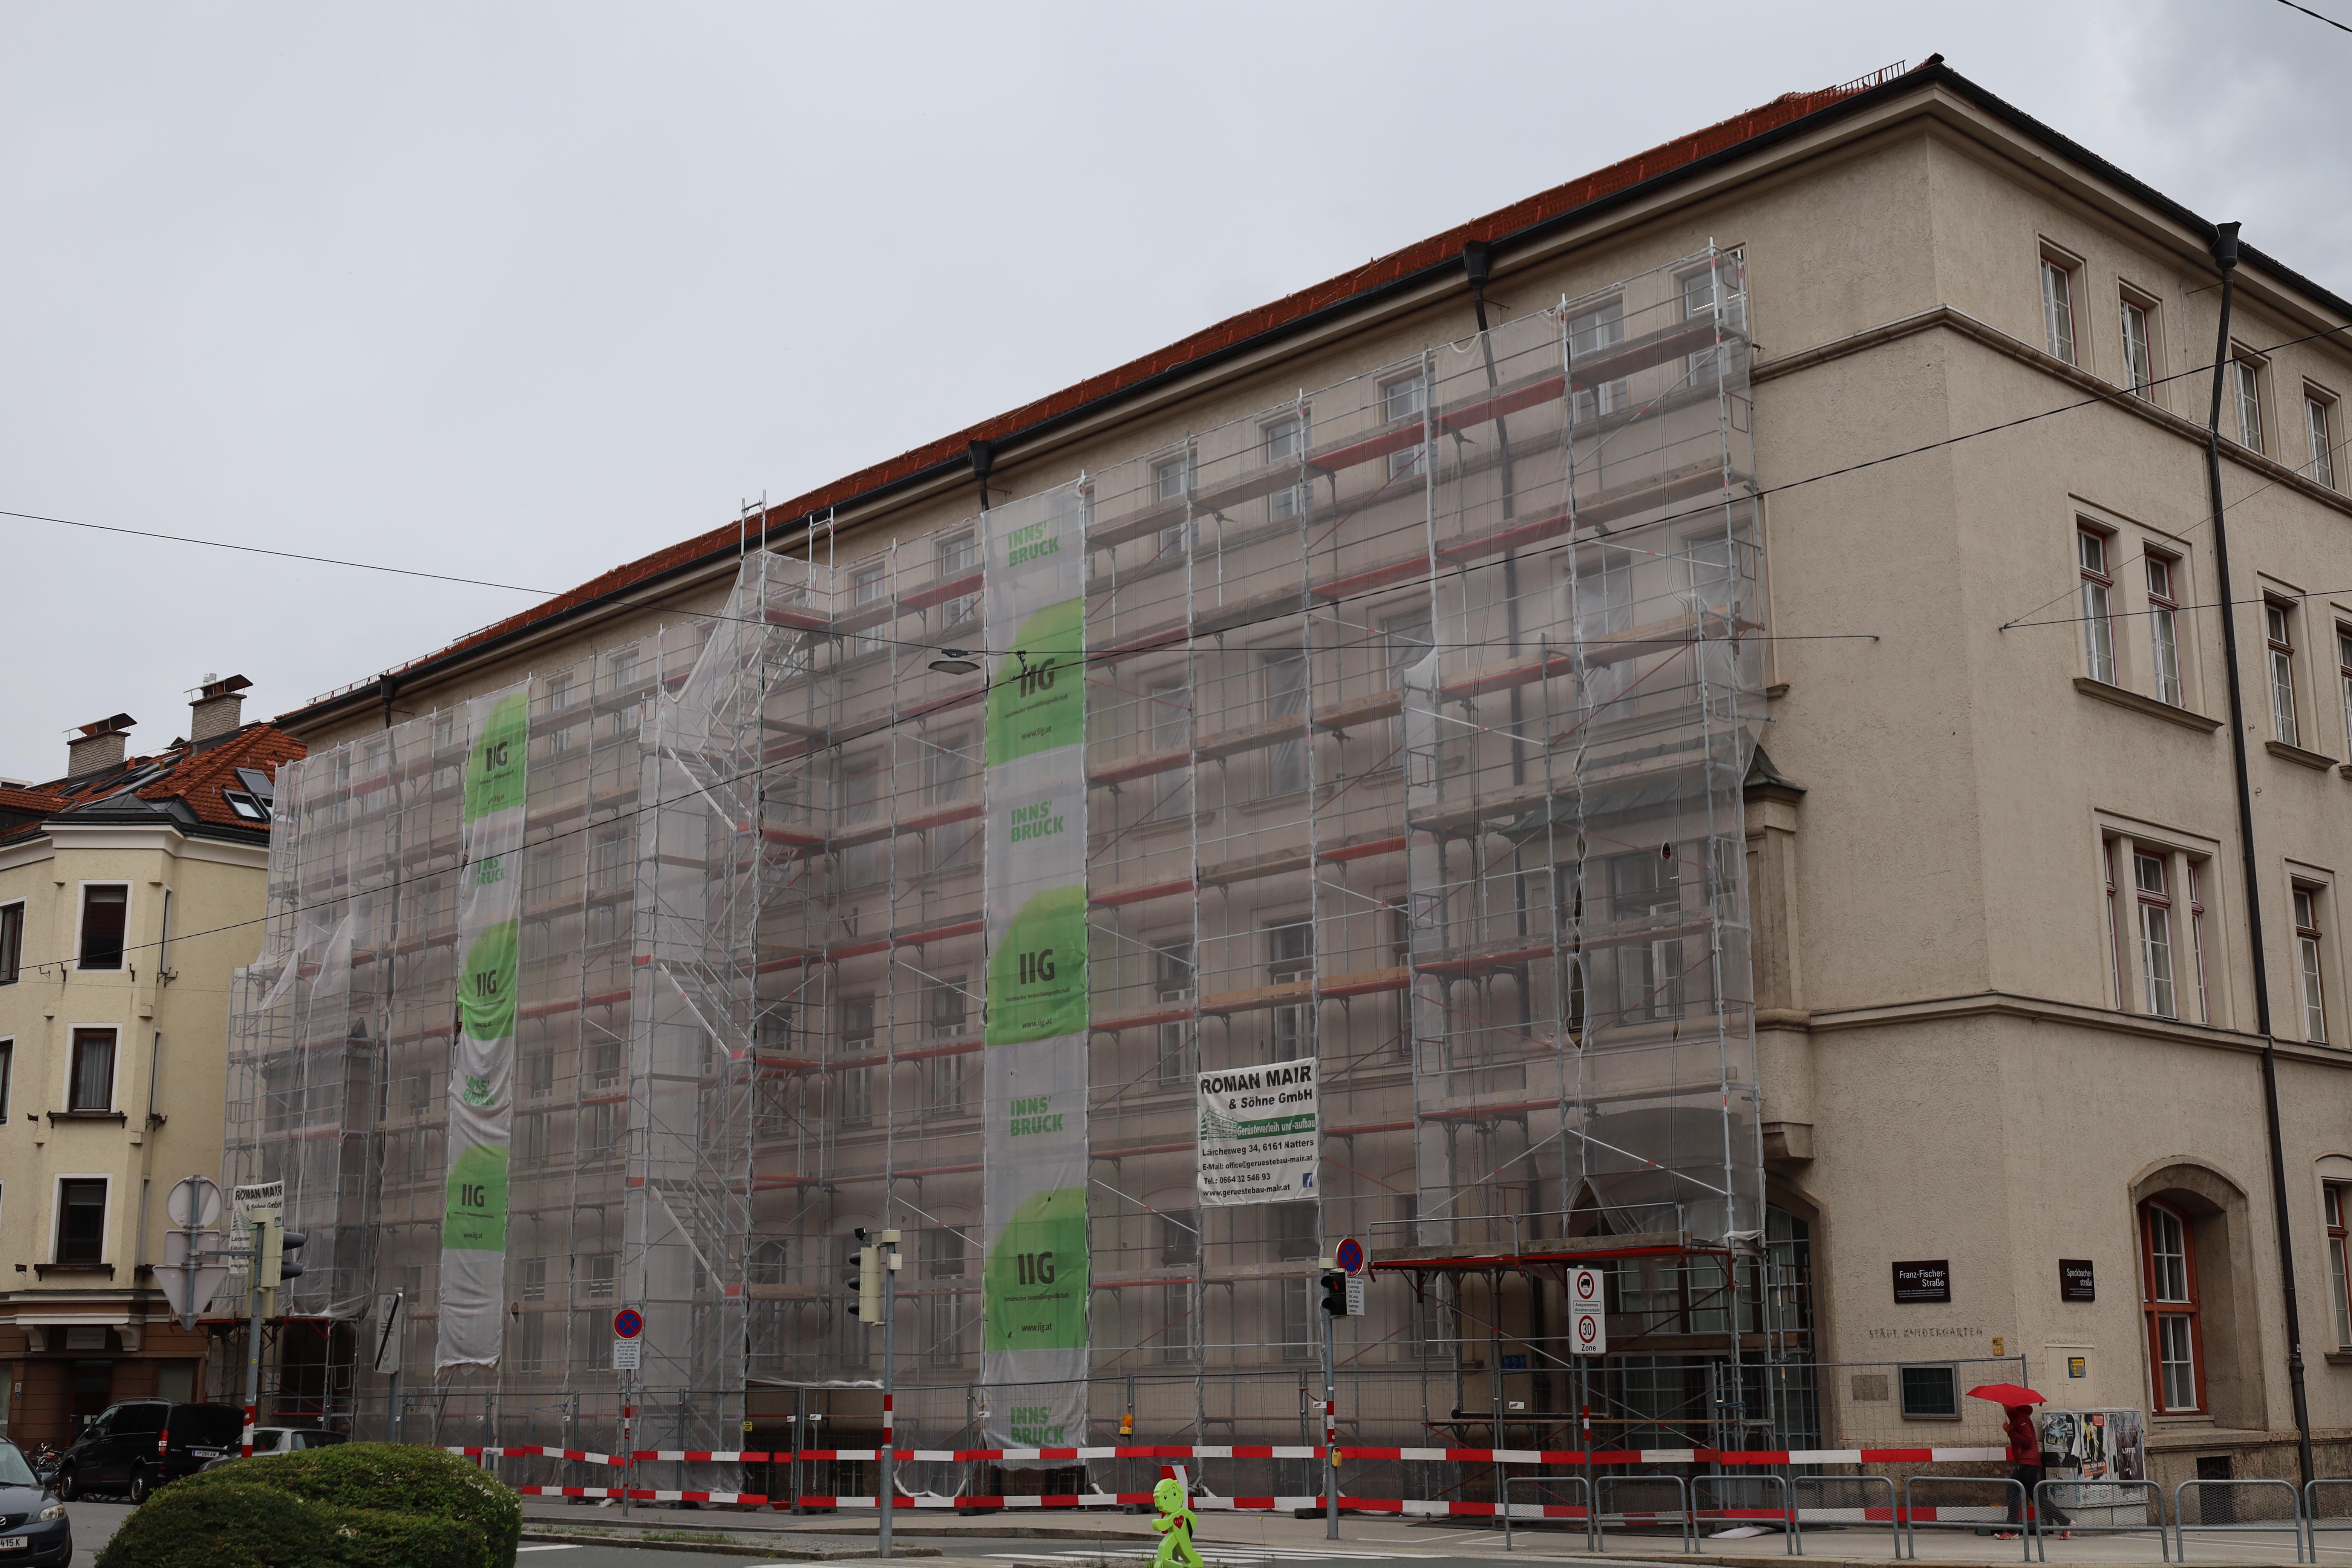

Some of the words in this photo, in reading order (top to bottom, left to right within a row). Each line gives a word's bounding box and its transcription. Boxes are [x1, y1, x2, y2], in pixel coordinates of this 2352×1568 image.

[1008, 520, 1047, 550] INNS'
[1009, 536, 1060, 567] BRUCK
[1020, 658, 1055, 698] IIG
[1021, 725, 1052, 740] www.iig.at
[1011, 800, 1052, 825] INNS'
[1011, 815, 1064, 843] BRUCK
[1020, 949, 1055, 985] IIG
[477, 969, 497, 997] IIG
[1022, 1017, 1052, 1028] www.iig.at
[1200, 1072, 1260, 1094] ROMAN
[1266, 1065, 1312, 1087] MAIR
[1011, 1095, 1052, 1117] INNS'
[1229, 1099, 1236, 1109] &
[1241, 1096, 1275, 1108] Söhne
[1279, 1089, 1312, 1104] GmbH
[1011, 1113, 1064, 1136] BRUCK
[1237, 1121, 1280, 1136] Gerüsteverleih
[1281, 1120, 1292, 1131] und
[1292, 1118, 1315, 1130] -aufbau
[1202, 1147, 1246, 1156] Lärchenweg
[1249, 1144, 1260, 1153] 34,
[1263, 1142, 1282, 1151] 6161
[1284, 1139, 1314, 1148] Natters
[1225, 1155, 1313, 1169] office@geruestebau-mair.at
[235, 1188, 261, 1201] ROMAN
[262, 1185, 282, 1198] MAIR
[462, 1184, 484, 1208] IIG
[1202, 1184, 1291, 1197] www.geruestebau-mair.at
[1018, 1251, 1055, 1285] IIG
[1900, 1269, 1945, 1279] Franz-Fischer-
[2067, 1268, 2093, 1278] Speckbacher-
[1922, 1278, 1944, 1287] Straße
[2080, 1278, 2092, 1286] straße
[1022, 1322, 1052, 1333] www.iig.at
[1583, 1323, 1592, 1335] 30
[1582, 1343, 1597, 1352] Zone
[1011, 1406, 1052, 1424] INNS'
[1011, 1426, 1064, 1444] BRUCK
[15, 1538, 21, 1546] K
